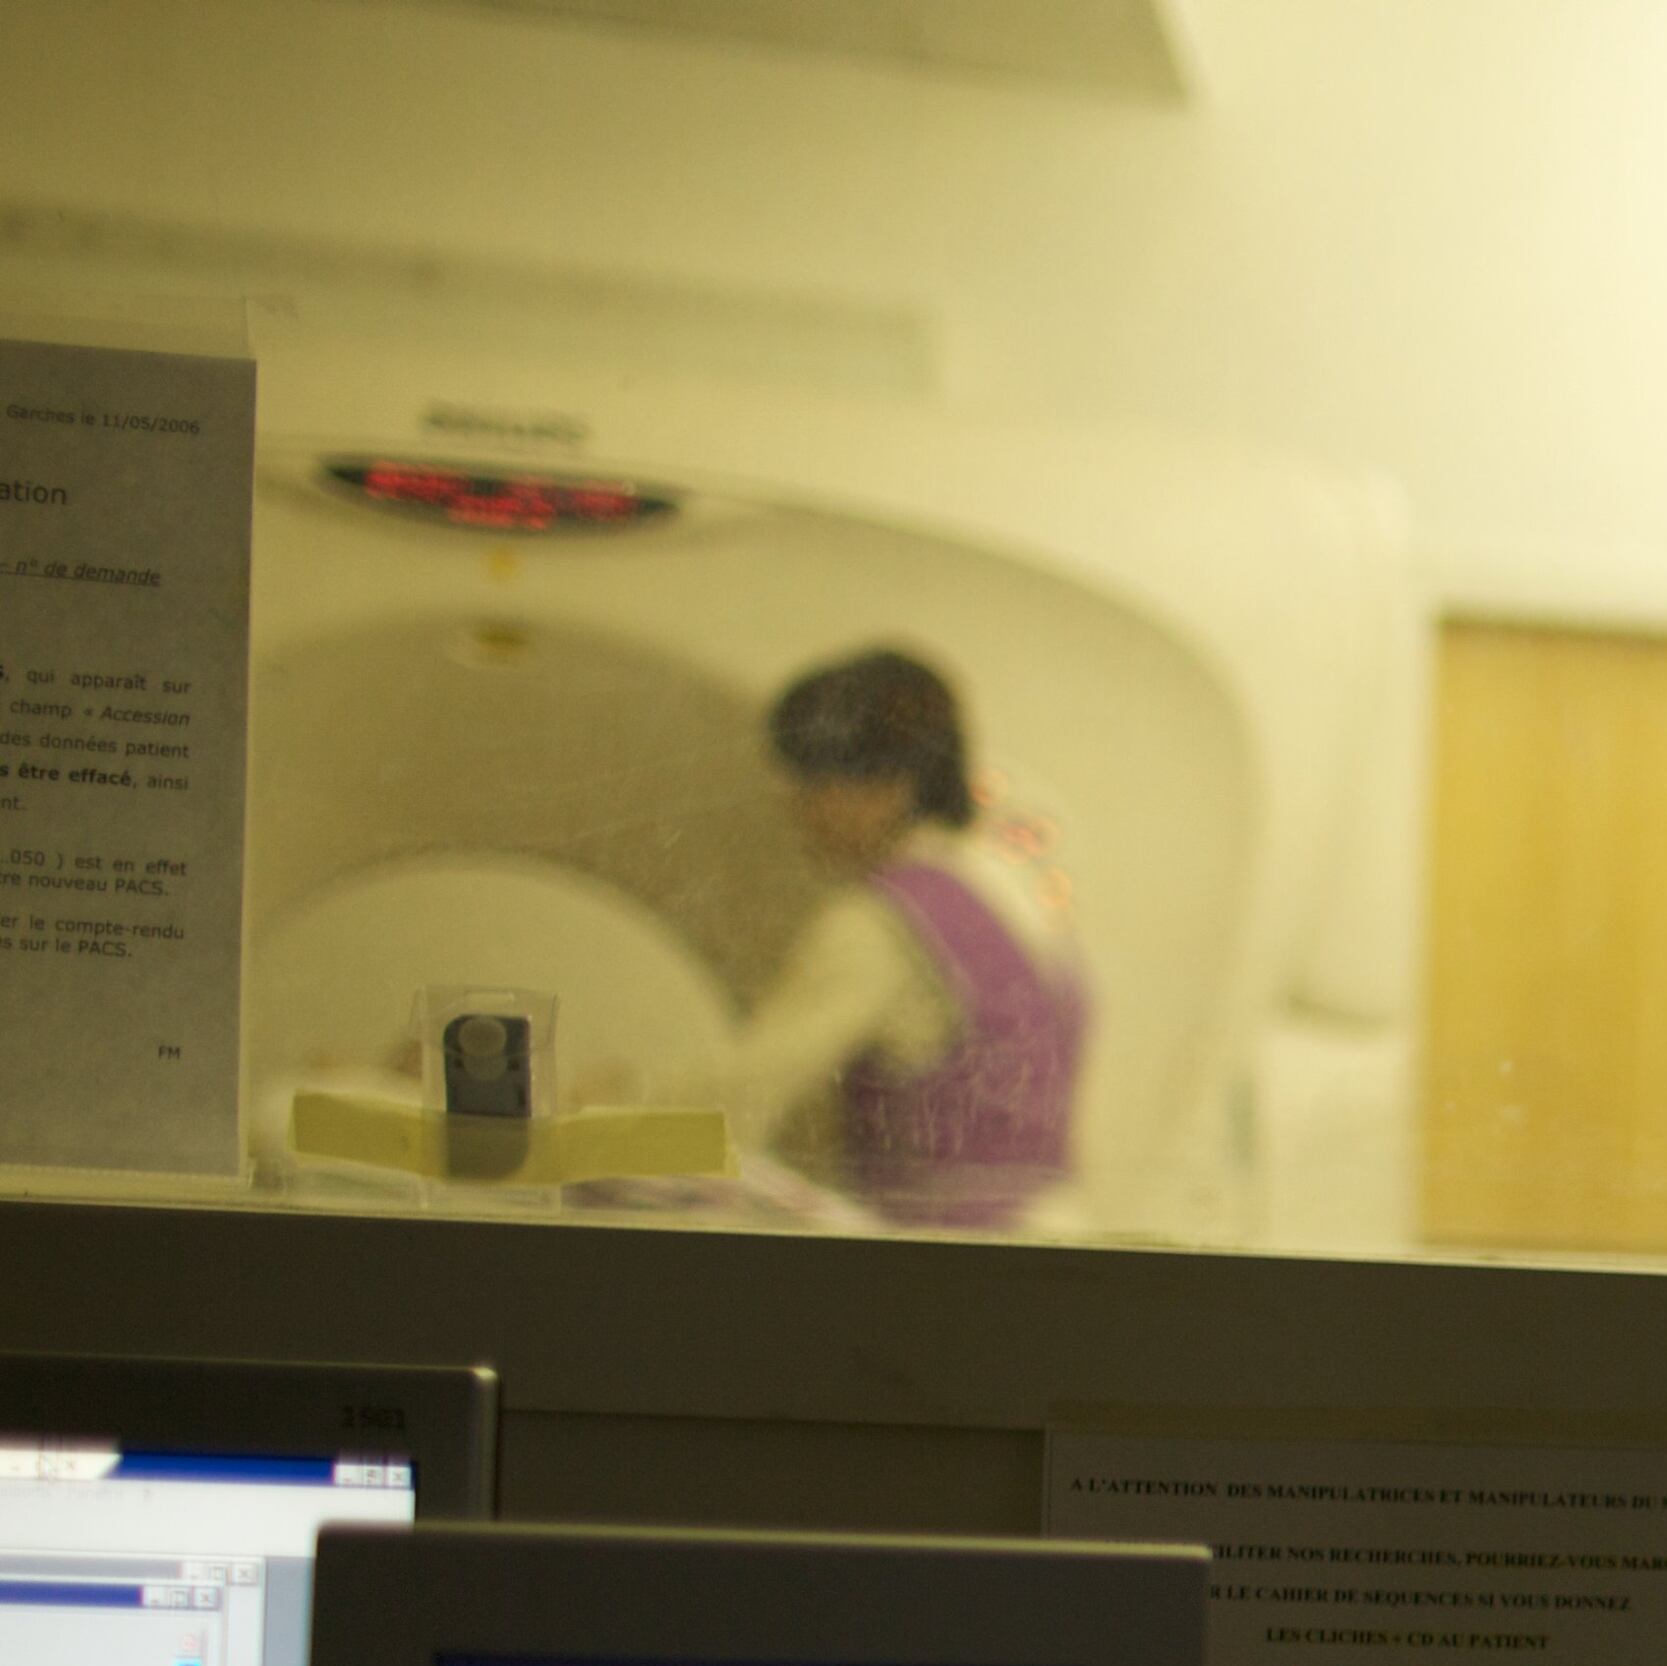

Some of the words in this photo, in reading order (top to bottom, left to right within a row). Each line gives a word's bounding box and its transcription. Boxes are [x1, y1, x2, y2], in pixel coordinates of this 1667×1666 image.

[103, 414, 200, 434] 11/05/2006
[0, 480, 67, 505] ation
[44, 562, 67, 578] de
[74, 563, 161, 587] demande
[27, 669, 55, 685] qui
[162, 679, 192, 694] sur
[10, 699, 72, 719] champ
[100, 706, 191, 726] Accession
[39, 733, 117, 754] données
[125, 739, 190, 758] patient
[18, 762, 60, 781] être
[147, 775, 189, 791] ainsi
[75, 856, 103, 870] est
[113, 859, 134, 872] en
[145, 858, 187, 876] effet
[28, 873, 107, 892] nouveau
[115, 880, 168, 896] PACS.
[29, 914, 46, 930] le
[55, 920, 185, 941] compte-rendu
[20, 940, 48, 952] sur
[55, 939, 72, 953] le
[78, 941, 132, 957] PACS.
[1071, 1479, 1083, 1491] A
[1088, 1479, 1218, 1497] L'ATTENTION
[1227, 1483, 1262, 1498] DES
[1267, 1485, 1435, 1504] MANIPULATRICES
[1440, 1488, 1462, 1504] ET
[1469, 1491, 1628, 1509] MANIPULATEURS
[1632, 1495, 1652, 1509] DU
[1288, 1546, 1325, 1561] NOS
[1330, 1548, 1463, 1567] RECHERCHES,
[1465, 1552, 1616, 1569] POURRIEZ-VOUS
[1227, 1586, 1249, 1600] LE
[1256, 1587, 1328, 1602] CAHIER
[1333, 1588, 1356, 1603] DE
[1478, 1592, 1495, 1608] SI
[1500, 1593, 1549, 1609] VOUS
[1554, 1595, 1631, 1612] DONNEZ
[1266, 1627, 1300, 1642] LES
[1306, 1628, 1387, 1644] CLICHES
[1407, 1632, 1435, 1646] CD
[1439, 1633, 1467, 1647] AU
[1470, 1634, 1548, 1649] PATIENT
